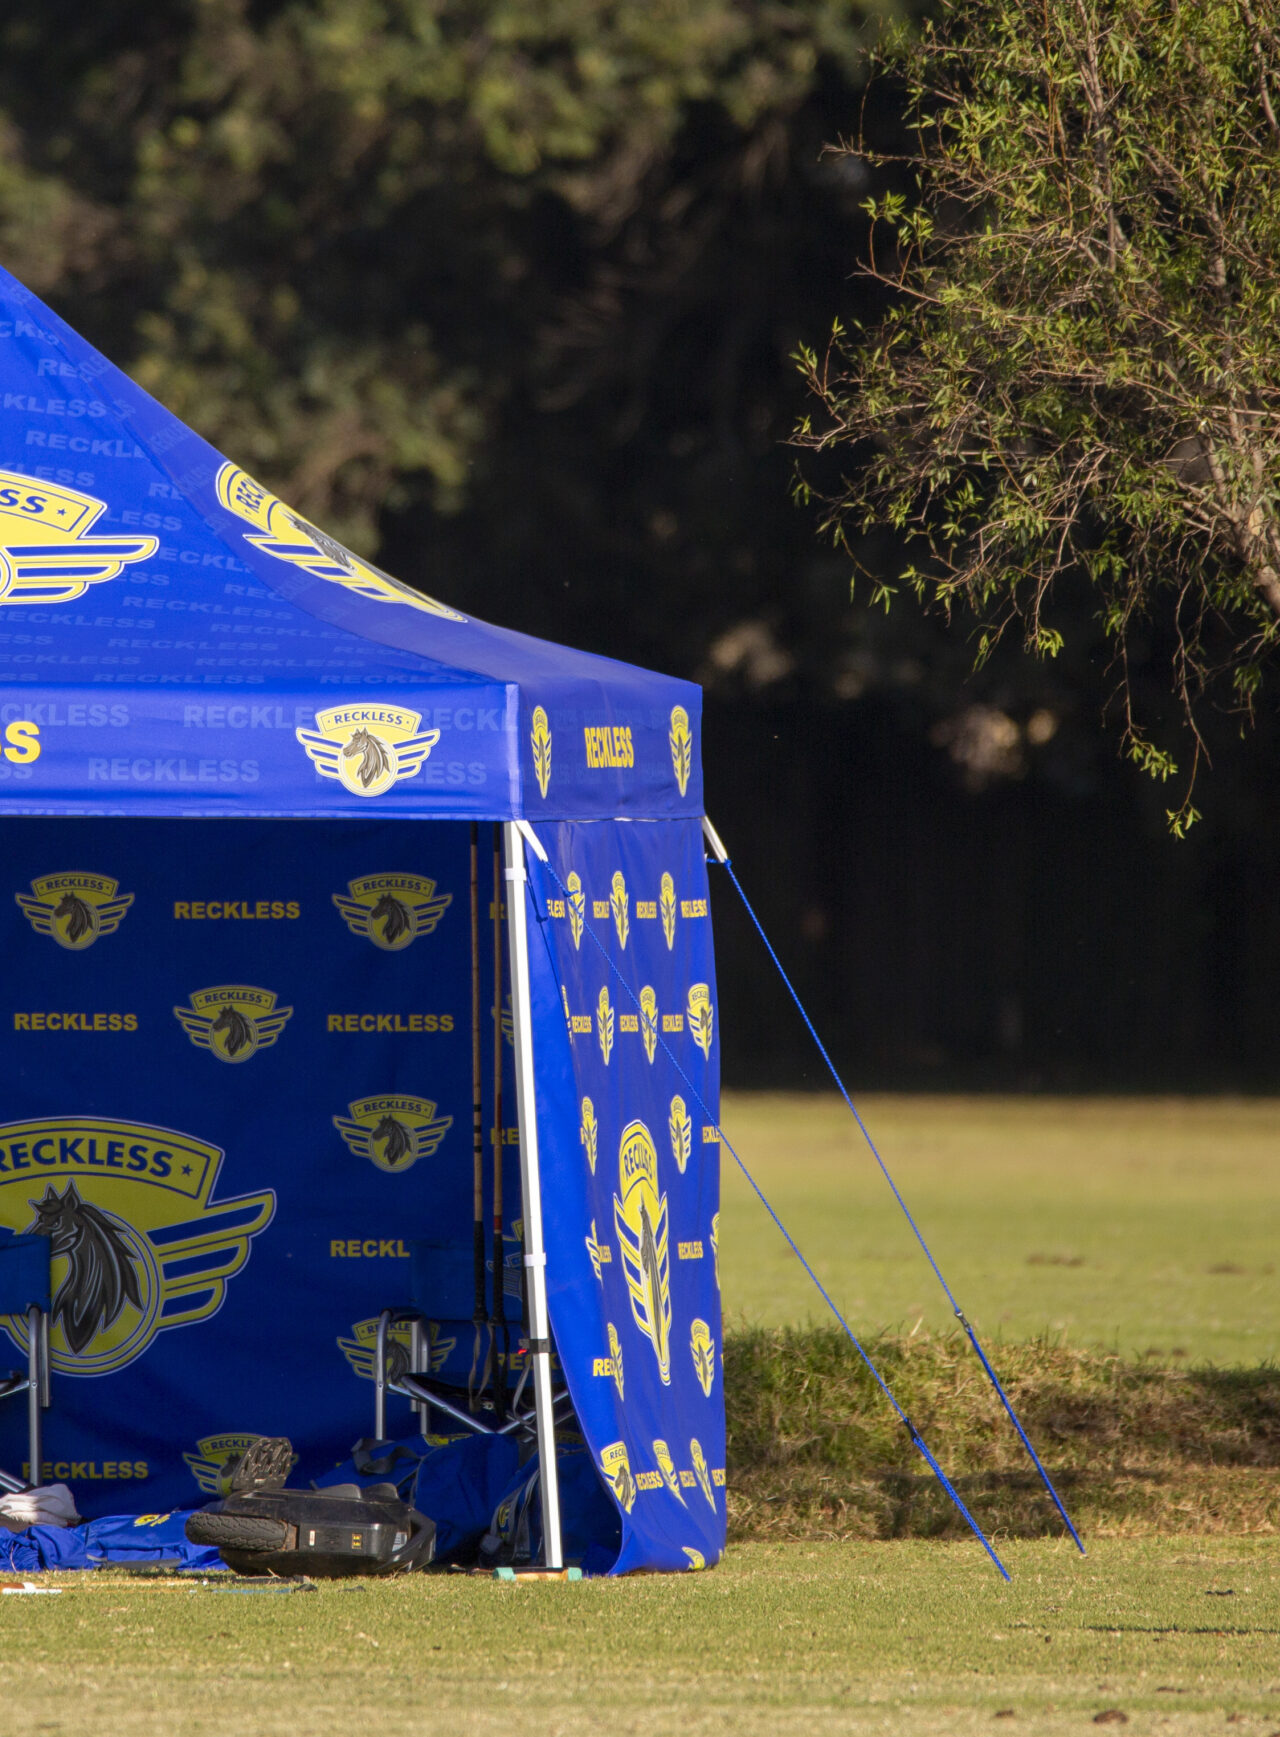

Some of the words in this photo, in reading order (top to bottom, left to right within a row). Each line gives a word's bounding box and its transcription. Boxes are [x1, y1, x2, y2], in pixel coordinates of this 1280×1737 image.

[122, 596, 294, 621] RECKLESS
[108, 638, 280, 651] RECKLESS
[93, 673, 265, 684] RECKLESS
[183, 705, 315, 729] RECKLE
[333, 710, 404, 726] RECKLESS
[583, 726, 634, 769] RECKLESS
[87, 758, 261, 783] RECKLESS
[45, 878, 104, 892] RECKLESS
[363, 878, 421, 892] RECKLESS
[174, 901, 300, 919] RECKLESS
[204, 991, 262, 1004] RECKLESS
[14, 1013, 138, 1031] RECKLESS
[327, 1014, 454, 1032] RECKLESS
[363, 1100, 422, 1113] RECKLESS
[330, 1240, 410, 1257] RECKL
